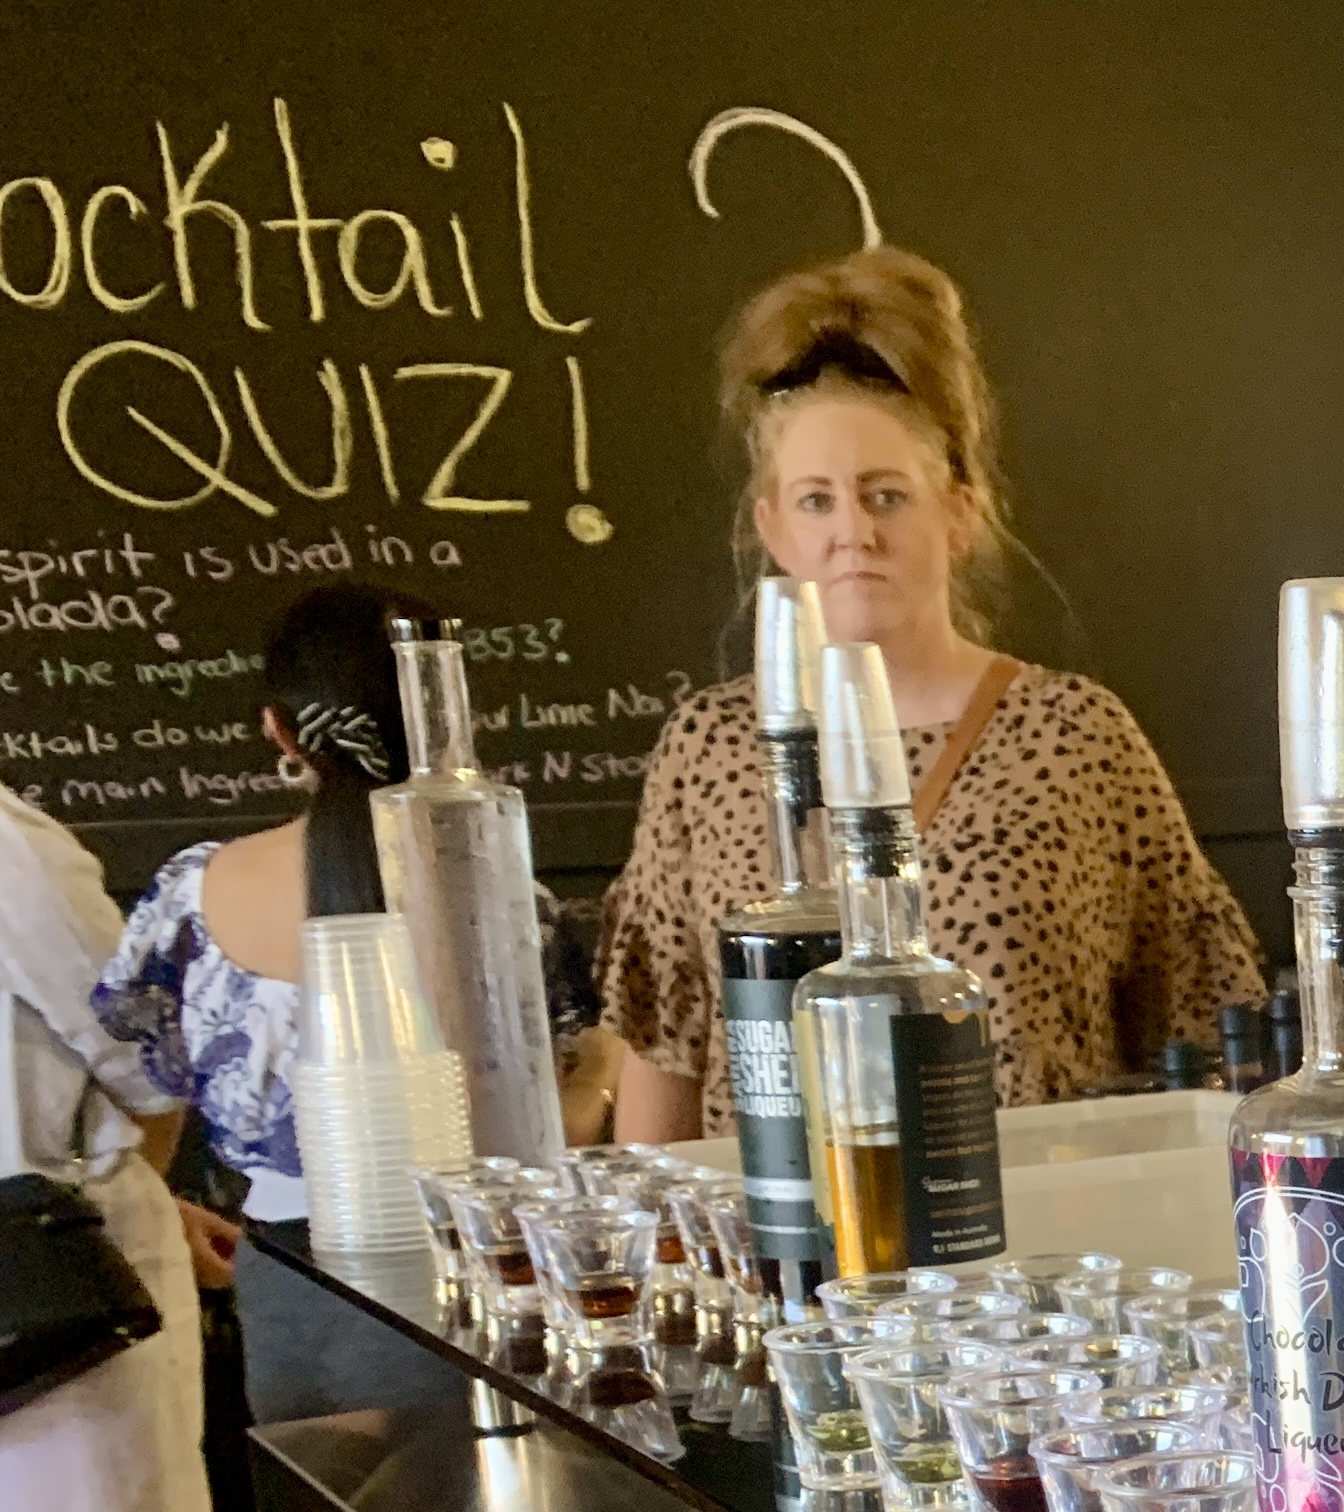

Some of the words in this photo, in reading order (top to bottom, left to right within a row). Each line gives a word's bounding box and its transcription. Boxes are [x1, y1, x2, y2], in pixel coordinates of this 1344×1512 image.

[57, 340, 613, 545] QUIZ!
[184, 548, 234, 581] is
[251, 528, 351, 575] used
[366, 524, 409, 567] in
[432, 540, 463, 568] a
[37, 656, 115, 686] the
[133, 720, 188, 747] do
[735, 1019, 796, 1053] SUGA
